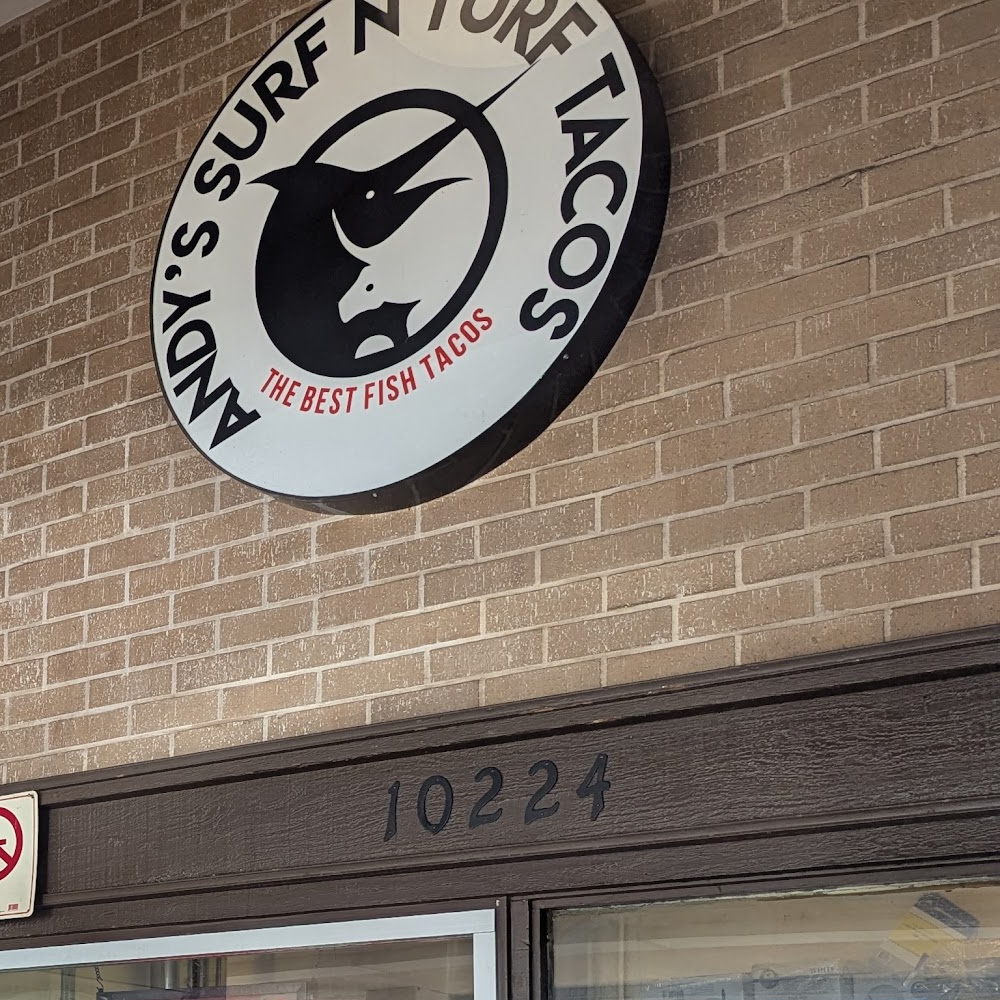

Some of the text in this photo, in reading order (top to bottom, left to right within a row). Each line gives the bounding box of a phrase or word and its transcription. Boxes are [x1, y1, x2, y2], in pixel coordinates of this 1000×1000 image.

[353, 0, 400, 55] N
[193, 18, 328, 202] SURF
[520, 52, 629, 341] TACOS
[162, 221, 261, 450] ANDY'S
[260, 306, 494, 415] THE BEST FISH TACOS
[383, 753, 611, 843] 10224
